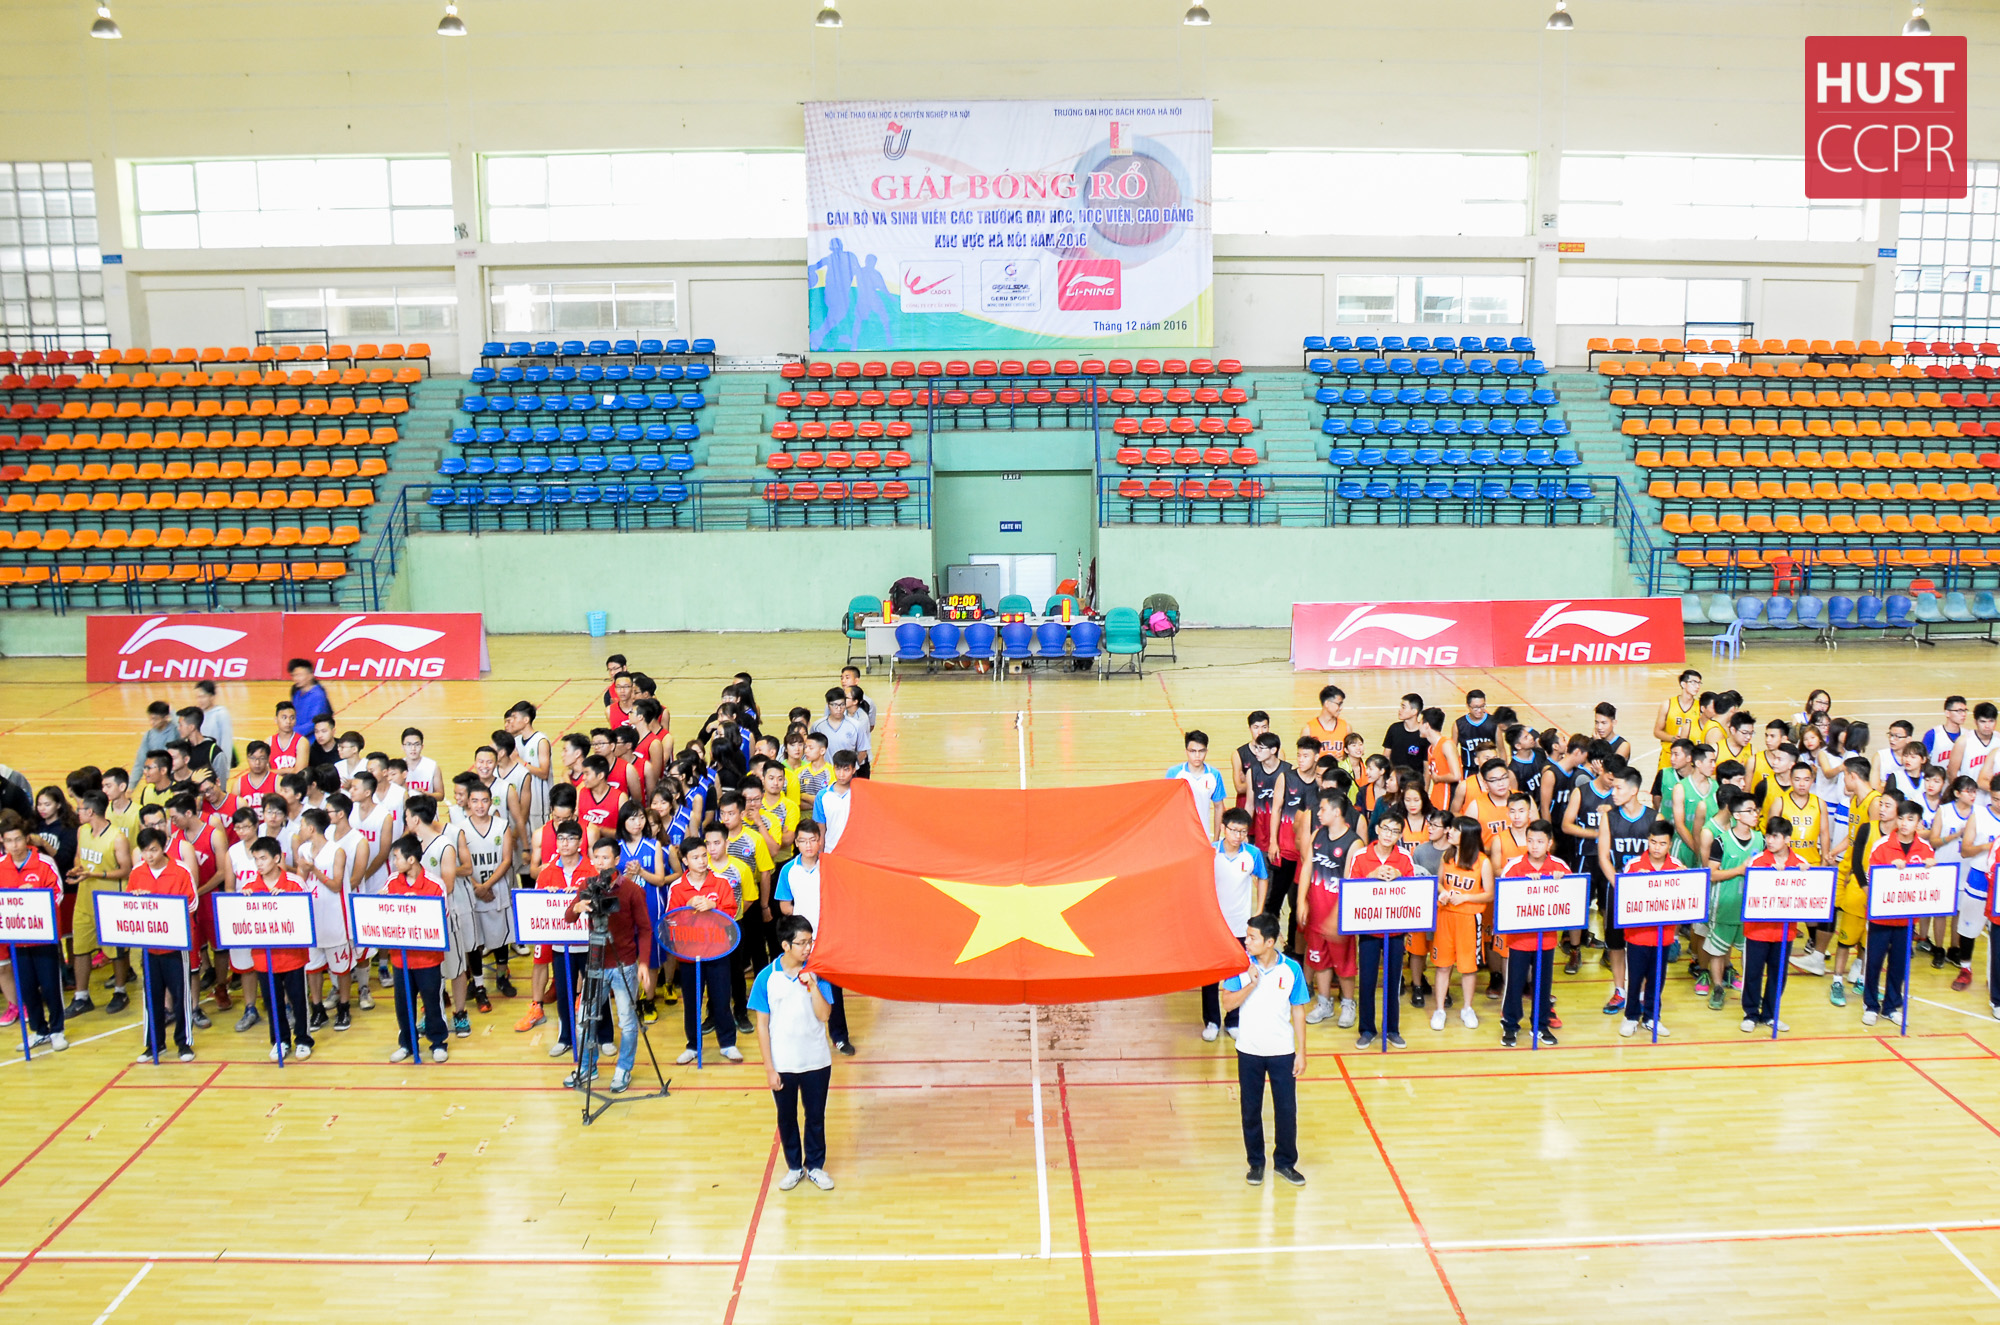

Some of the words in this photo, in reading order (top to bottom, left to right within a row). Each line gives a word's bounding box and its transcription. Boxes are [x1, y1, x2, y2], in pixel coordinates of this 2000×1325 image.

[1137, 108, 1156, 116] KHOA
[871, 166, 953, 200] GIẢI
[967, 168, 1077, 200] BÓNG
[1089, 161, 1147, 199] RỔ
[891, 211, 917, 225] SINH
[1079, 209, 1102, 226] HỌC
[1137, 208, 1160, 223] CAO
[935, 234, 958, 248] KHU
[1059, 232, 1087, 247] 2016
[1066, 287, 1115, 296] LI-NING
[1093, 321, 1122, 332] Tháng
[1126, 321, 1137, 331] 12
[1163, 321, 1187, 331] 2016
[949, 595, 976, 606] 10:00
[1327, 646, 1459, 667] LI-NING
[1525, 641, 1652, 663] LI-NING
[117, 657, 248, 679] LI-NING
[314, 657, 446, 678] LI-NING
[80, 847, 103, 865] NEU
[472, 852, 498, 866] VNUA
[1445, 873, 1475, 890] TLU
[1882, 891, 1896, 904] LAO
[1547, 902, 1571, 916] LONG
[1626, 900, 1643, 913] GIAO
[147, 920, 169, 933] GIAO
[254, 922, 267, 934] GIA
[424, 928, 440, 940] NAM
[334, 948, 350, 964] 14
